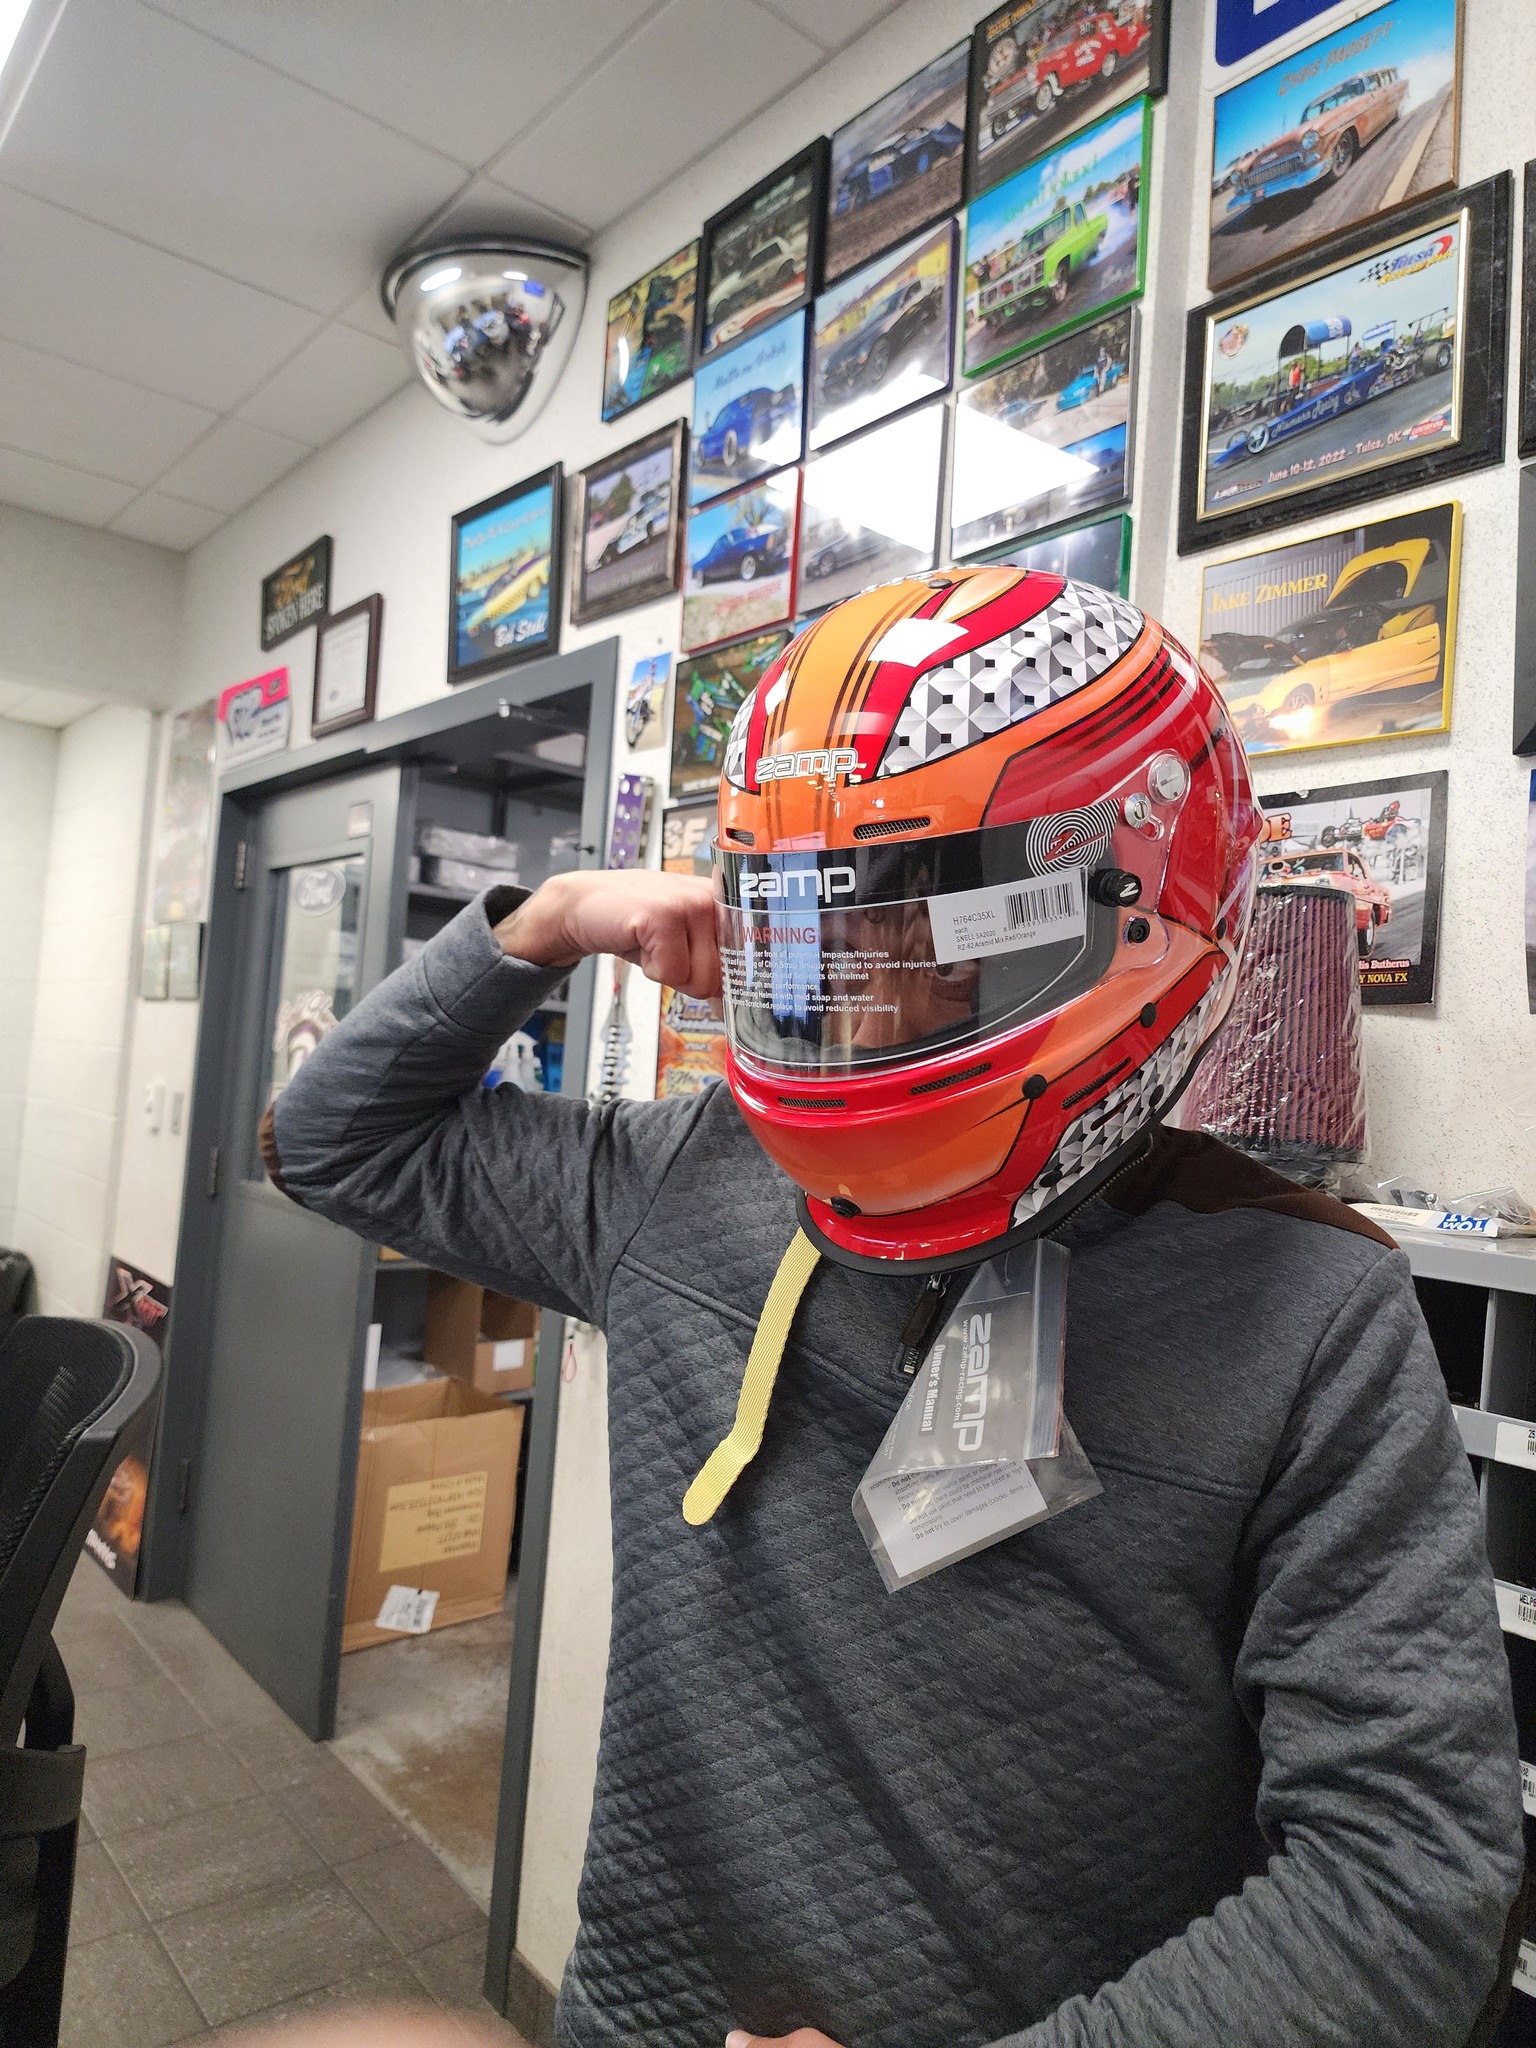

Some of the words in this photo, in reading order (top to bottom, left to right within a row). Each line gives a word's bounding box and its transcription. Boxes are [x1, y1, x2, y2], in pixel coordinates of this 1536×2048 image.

[1318, 448, 1347, 467] 2022
[1387, 430, 1402, 445] OK
[1208, 592, 1250, 615] JAKE
[1255, 573, 1328, 604] ZIMMER
[755, 747, 858, 784] zamp
[739, 866, 856, 903] zamp
[952, 910, 996, 925] H764C35XL
[741, 926, 816, 944] WARNING
[955, 926, 968, 935] each
[956, 934, 975, 943] SNELL
[976, 930, 996, 939] SA2020
[975, 939, 994, 948] Aramid
[1005, 930, 1036, 943] Red/Orange
[821, 950, 890, 960] Impacts/Injuries
[827, 961, 861, 971] required
[864, 961, 873, 969] to
[875, 960, 900, 969] avoid
[902, 960, 937, 971] injuries
[840, 972, 869, 980] helmet
[1367, 973, 1393, 983] NOVA
[1394, 972, 1408, 982] FX
[811, 995, 831, 1003] soap
[805, 1003, 824, 1012] avoid
[825, 1004, 859, 1012] reduced
[861, 1004, 898, 1014] visibility
[928, 1344, 946, 1387] Owner's
[954, 1319, 969, 1421] www.zamp-racing.com
[952, 1313, 992, 1452] zamp
[921, 1388, 939, 1432] Manual
[900, 1475, 911, 1483] not
[915, 1531, 924, 1540] Do
[924, 1526, 935, 1537] not
[964, 1502, 988, 1518] damages
